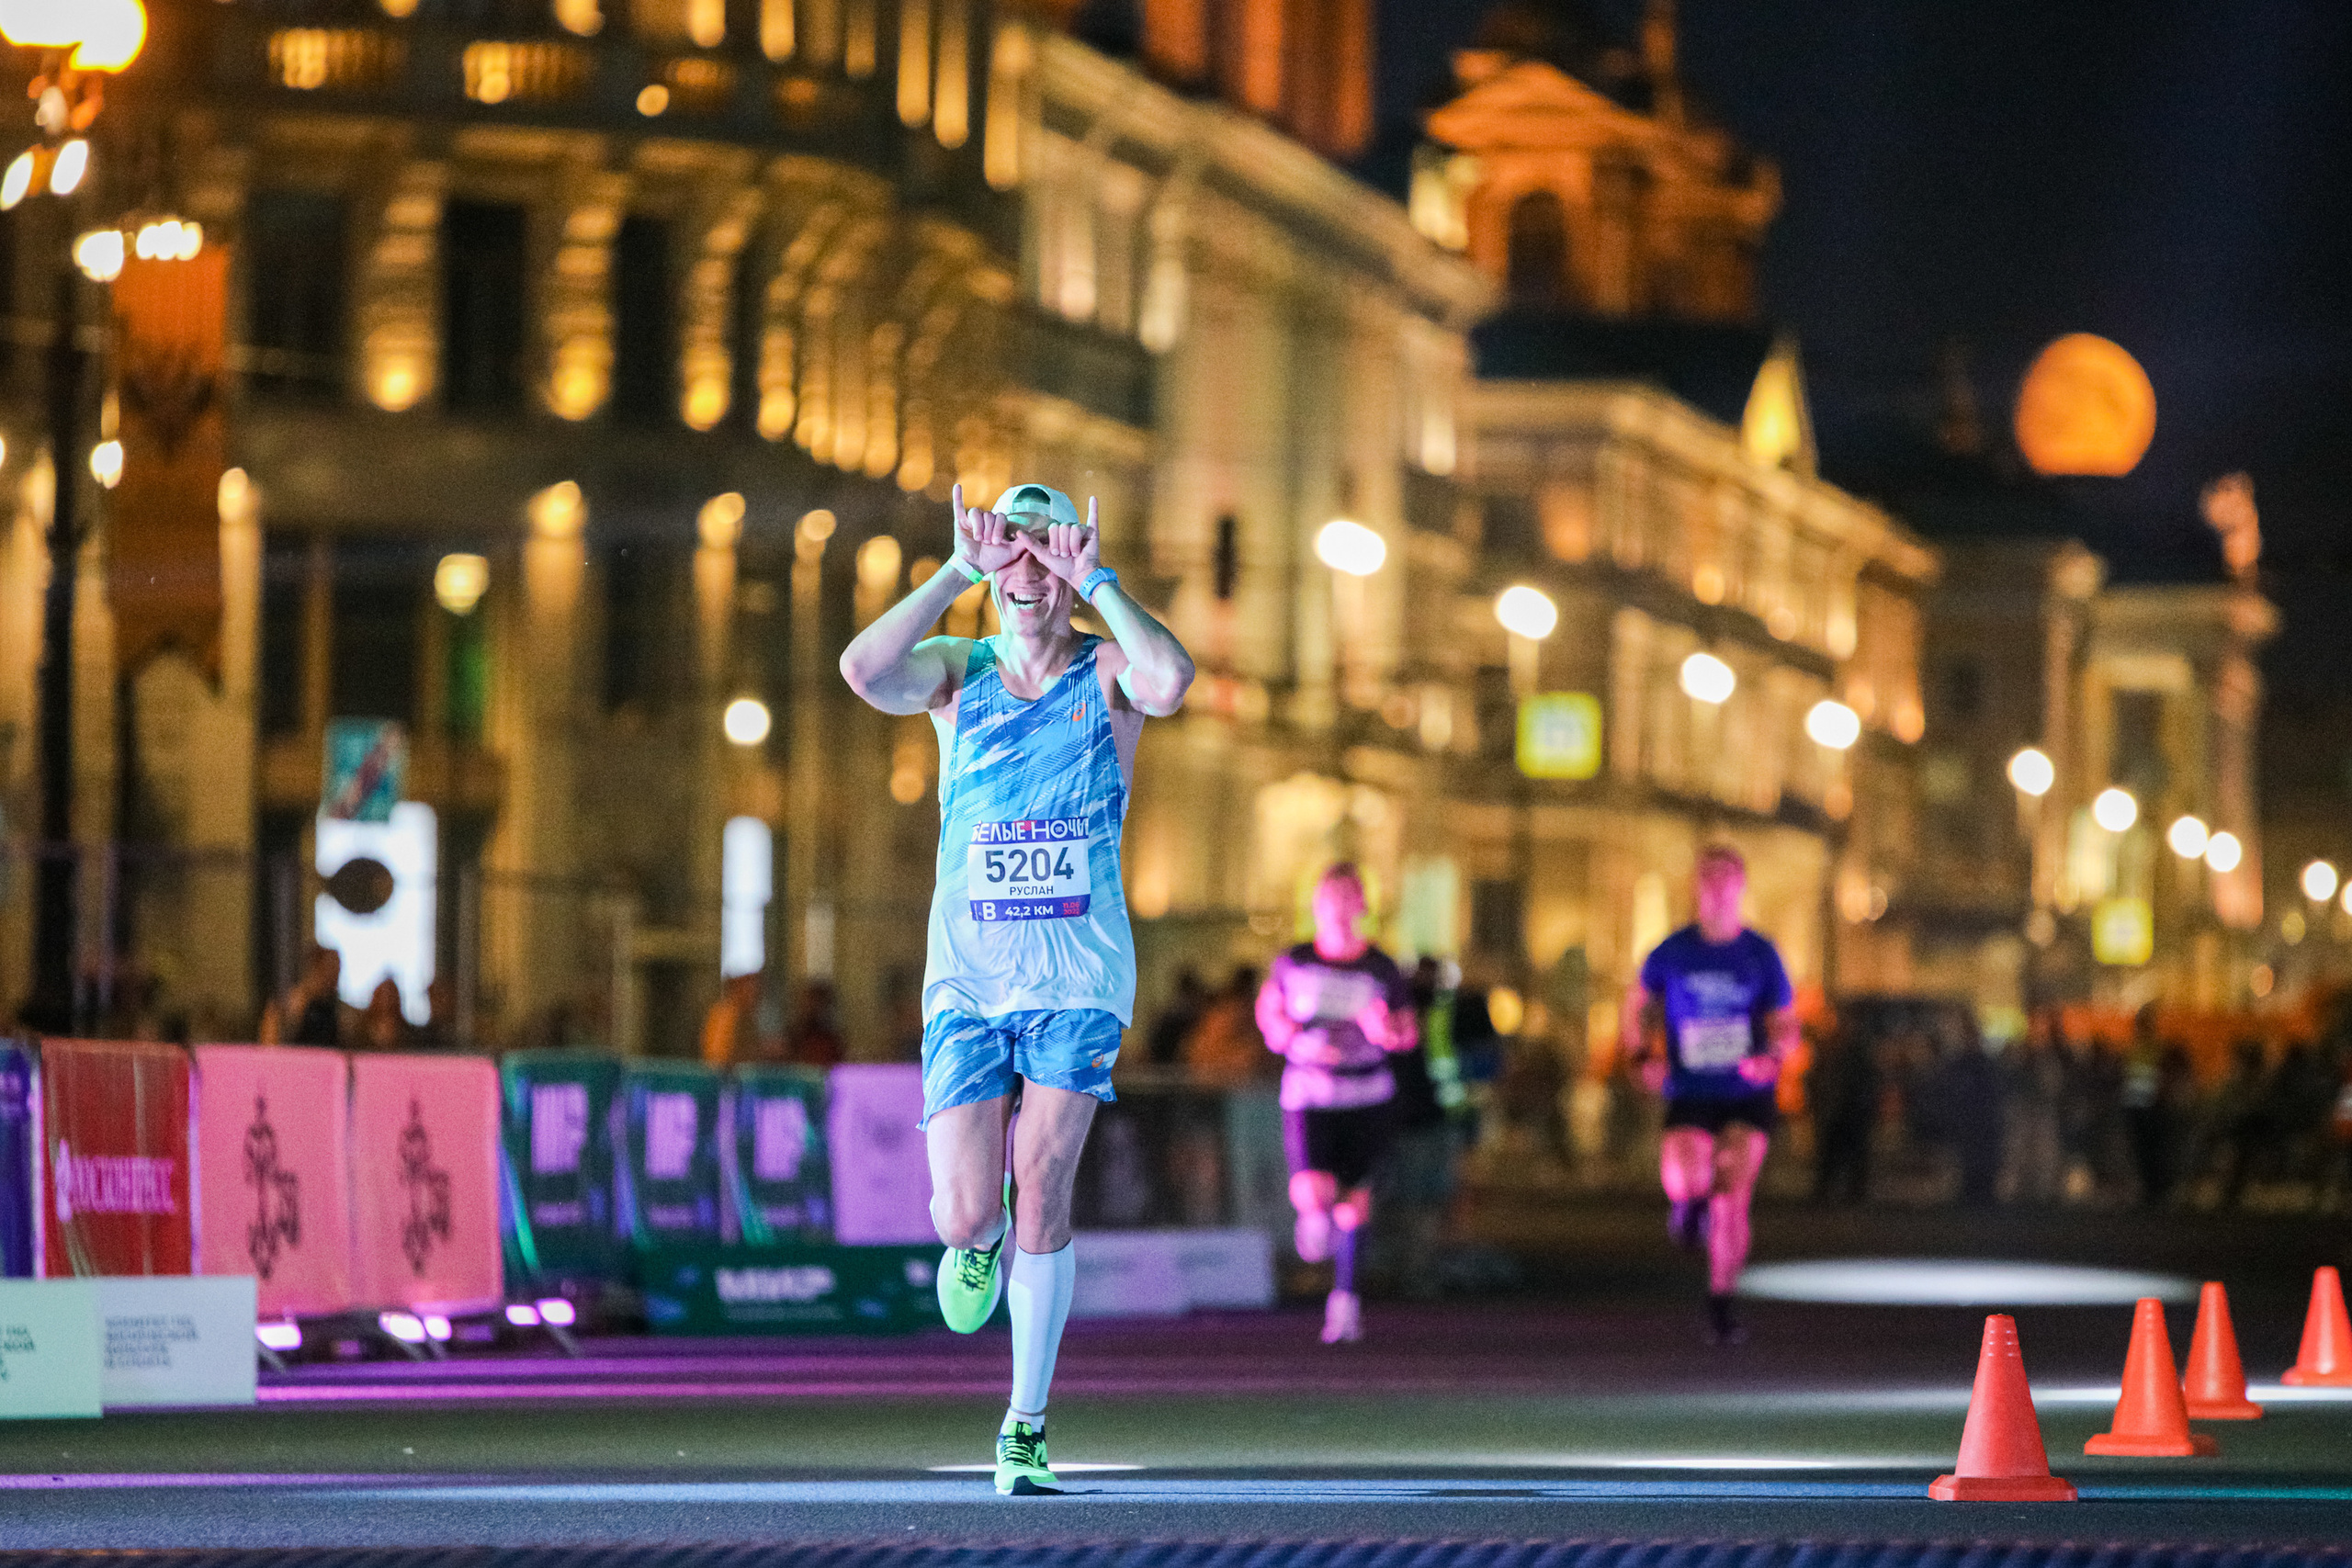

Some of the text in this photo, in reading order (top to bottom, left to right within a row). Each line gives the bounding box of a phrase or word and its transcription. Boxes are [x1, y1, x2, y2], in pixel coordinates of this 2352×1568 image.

[1031, 818, 1089, 840] НОЧИ
[985, 846, 1074, 883] 5204
[1009, 886, 1054, 896] РУСЛАН
[1005, 906, 1031, 918] 42,2
[1034, 905, 1054, 916] КМ
